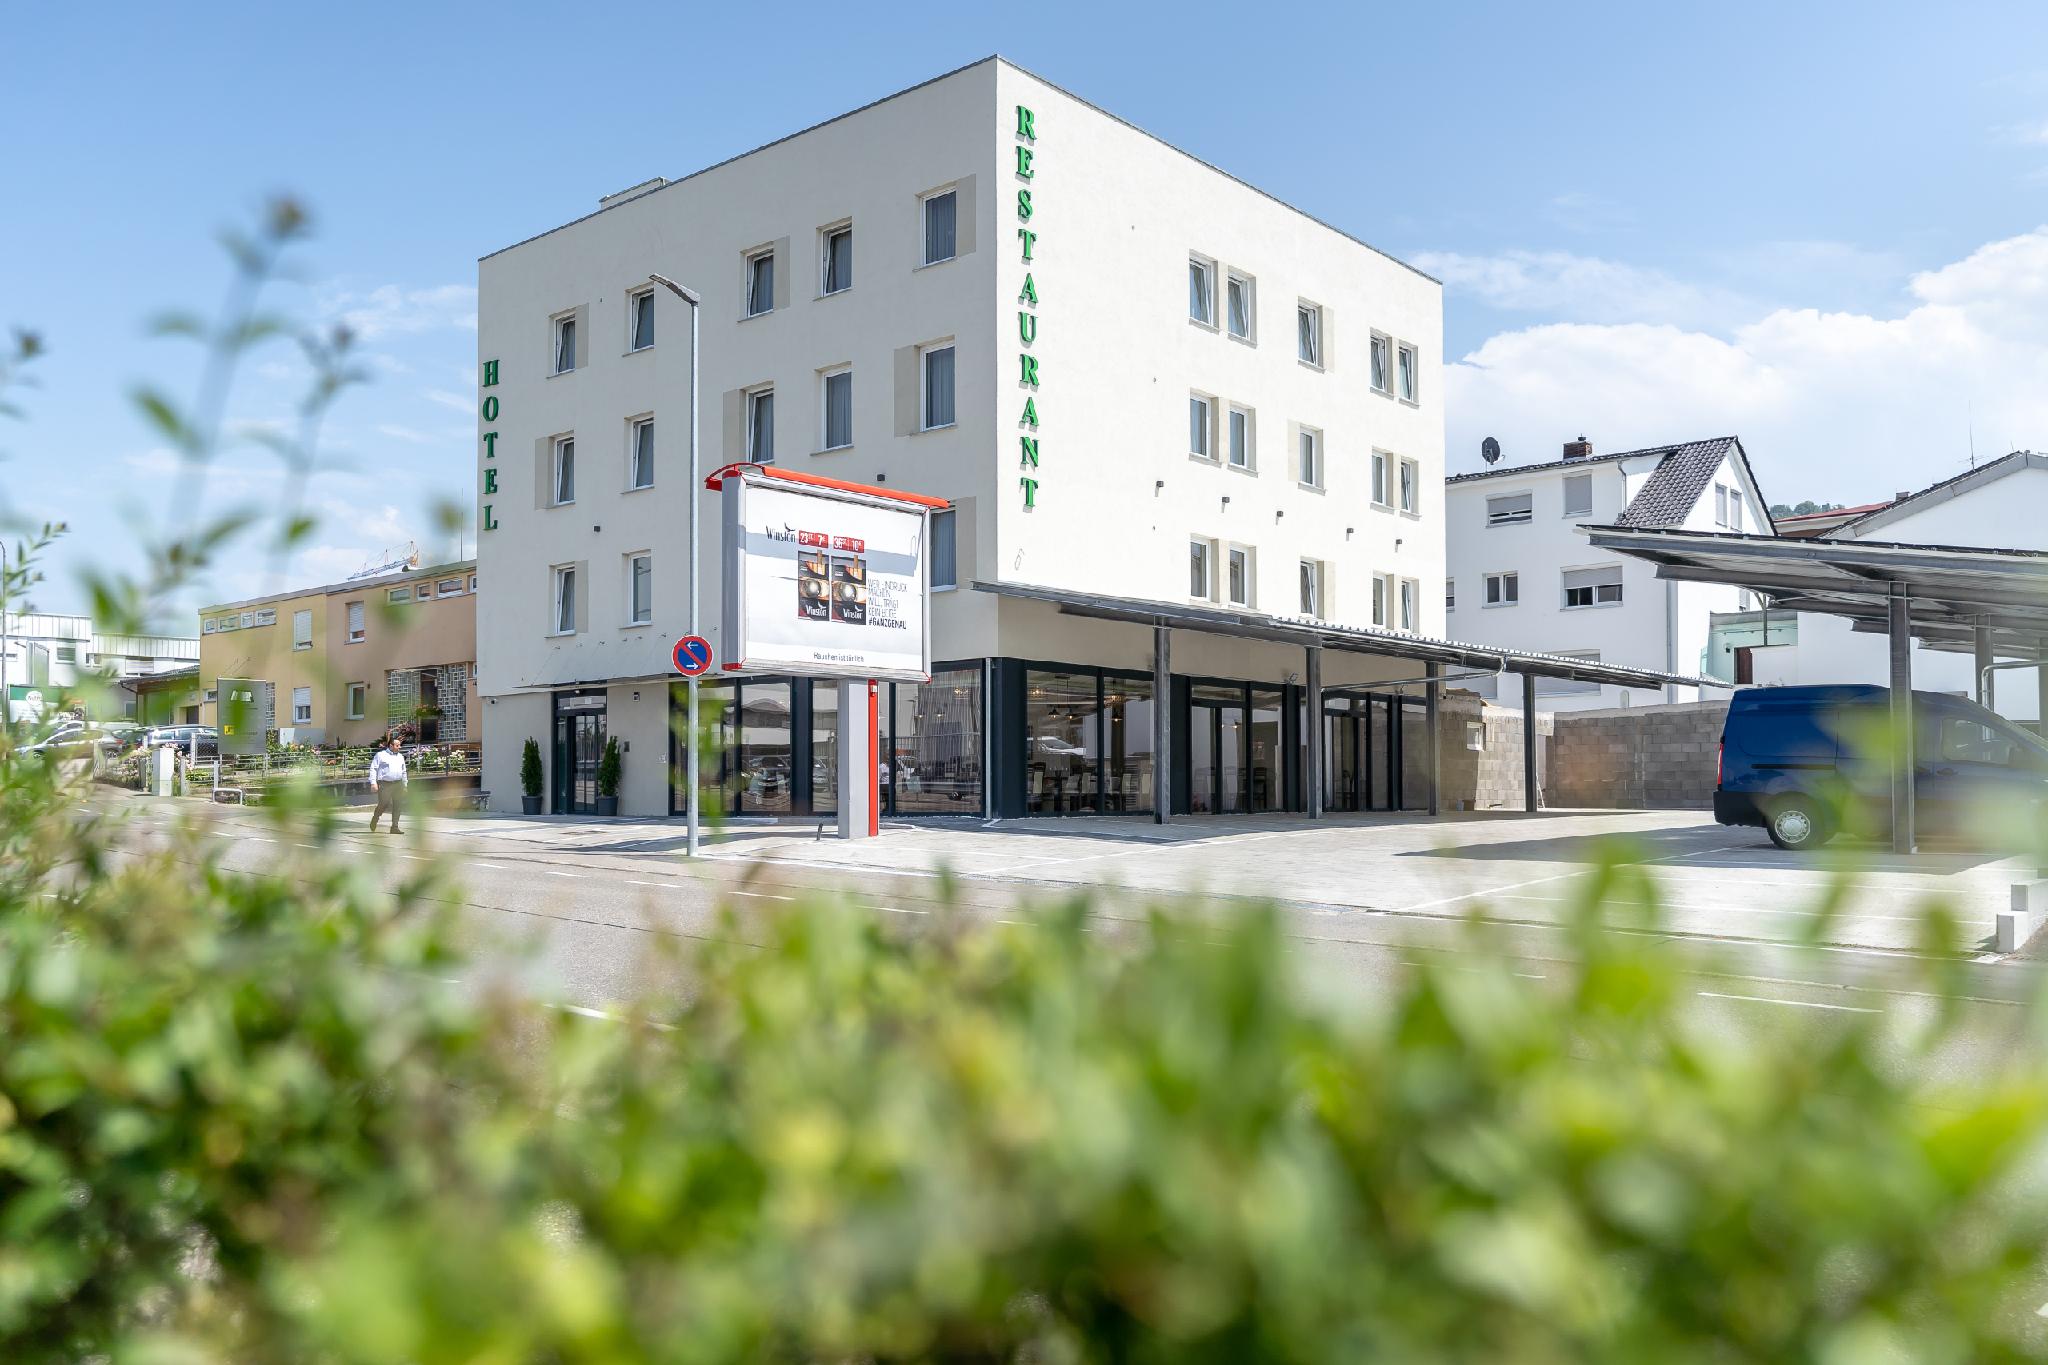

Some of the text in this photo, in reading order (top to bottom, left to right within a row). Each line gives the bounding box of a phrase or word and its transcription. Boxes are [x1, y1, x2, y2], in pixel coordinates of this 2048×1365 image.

[1016, 105, 1042, 507] RESTAURANT
[482, 359, 500, 531] HOTEL
[765, 524, 796, 543] Winston
